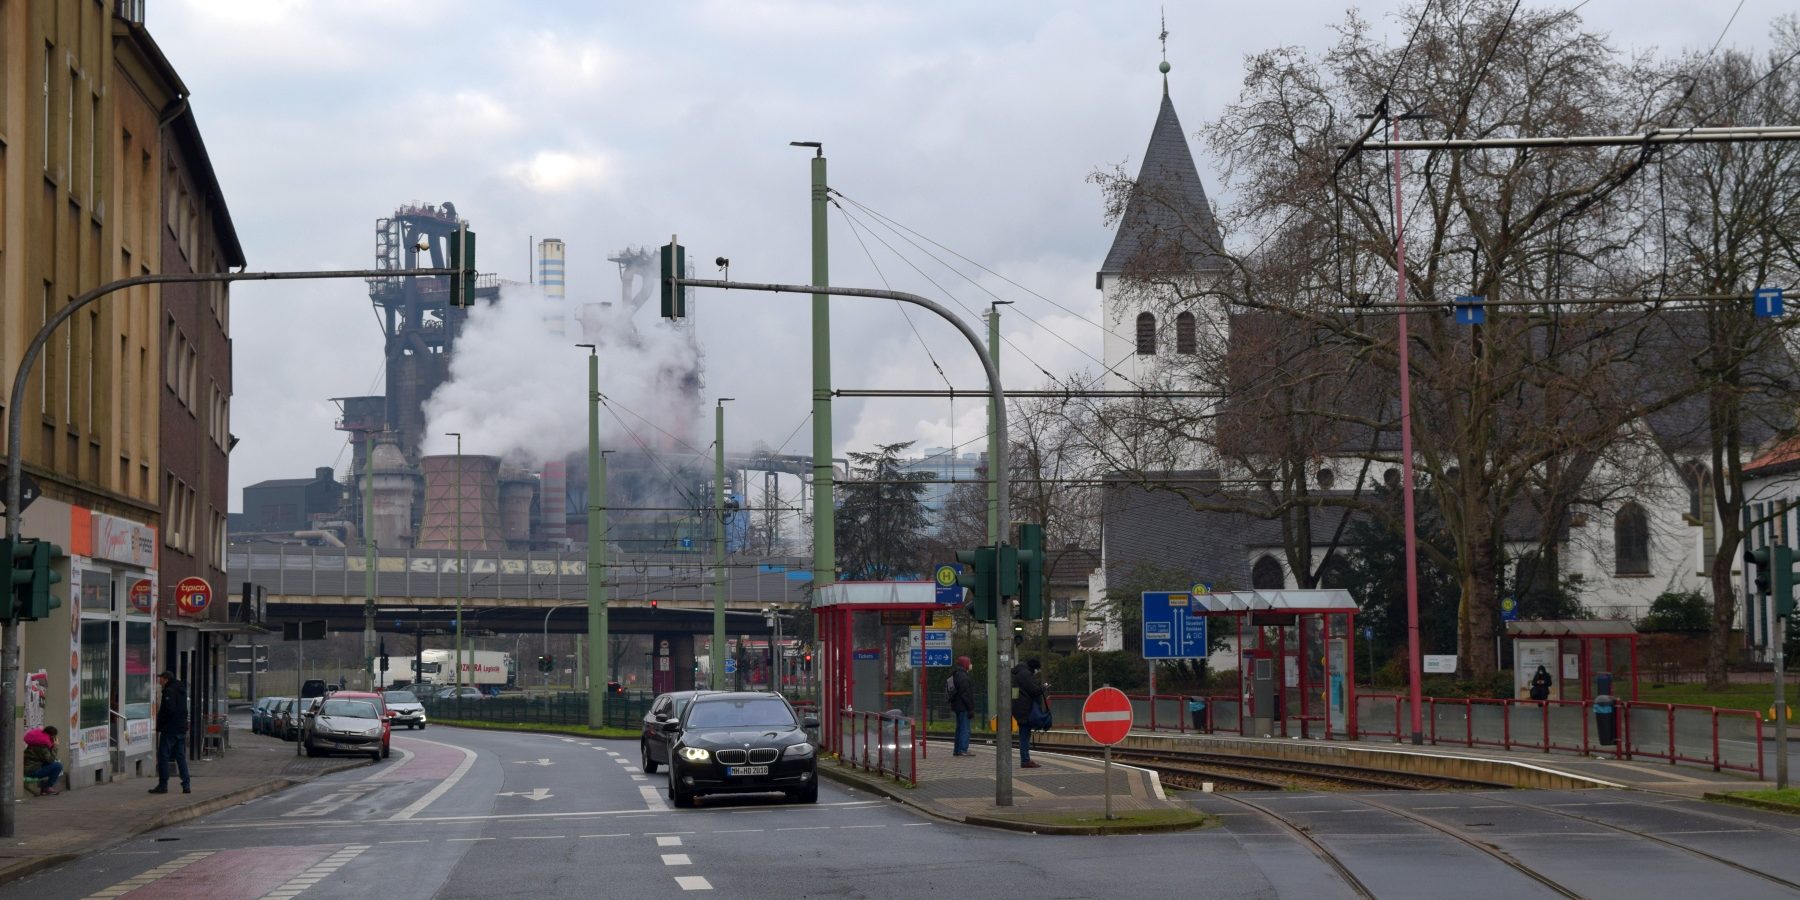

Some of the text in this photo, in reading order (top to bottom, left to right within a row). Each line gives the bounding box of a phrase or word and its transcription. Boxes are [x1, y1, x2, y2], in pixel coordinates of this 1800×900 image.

[942, 571, 951, 581] H
[180, 583, 206, 593] tipico
[195, 594, 204, 606] P
